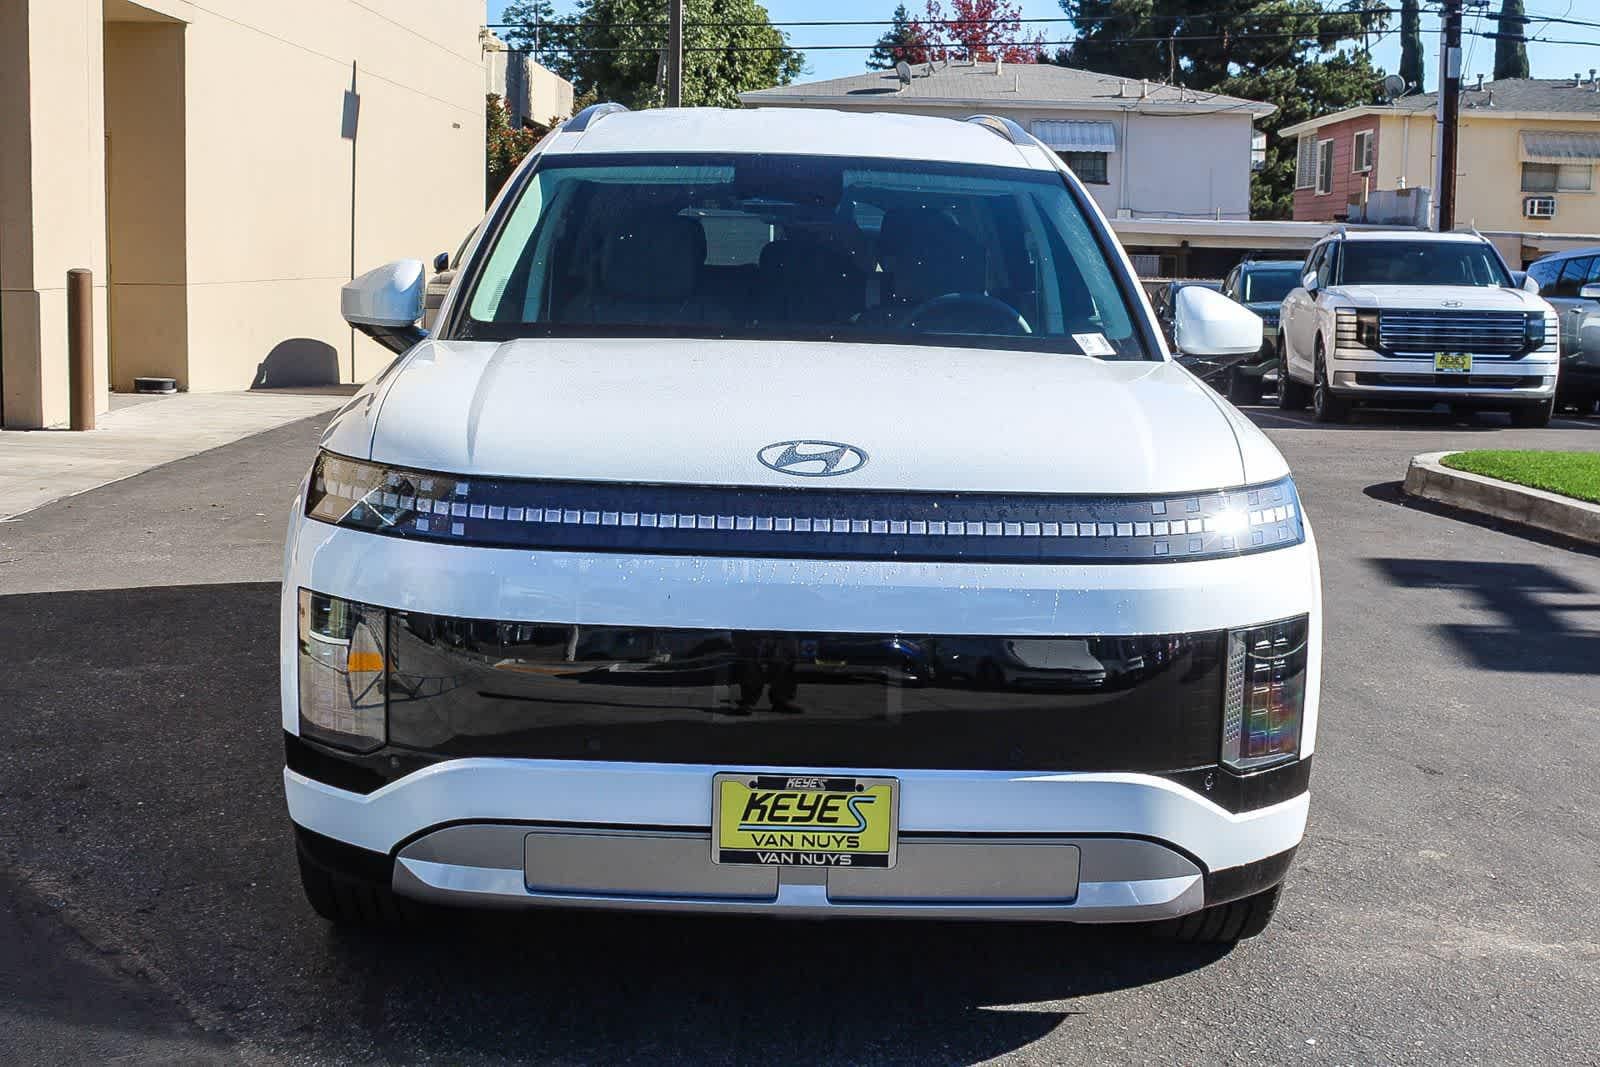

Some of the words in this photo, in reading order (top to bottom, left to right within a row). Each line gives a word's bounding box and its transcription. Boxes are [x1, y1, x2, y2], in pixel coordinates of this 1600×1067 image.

[740, 792, 877, 831] KEYES
[751, 834, 793, 847] VAN
[801, 835, 860, 848] NUYS
[756, 853, 793, 864] VAN
[800, 854, 852, 865] NUYS
